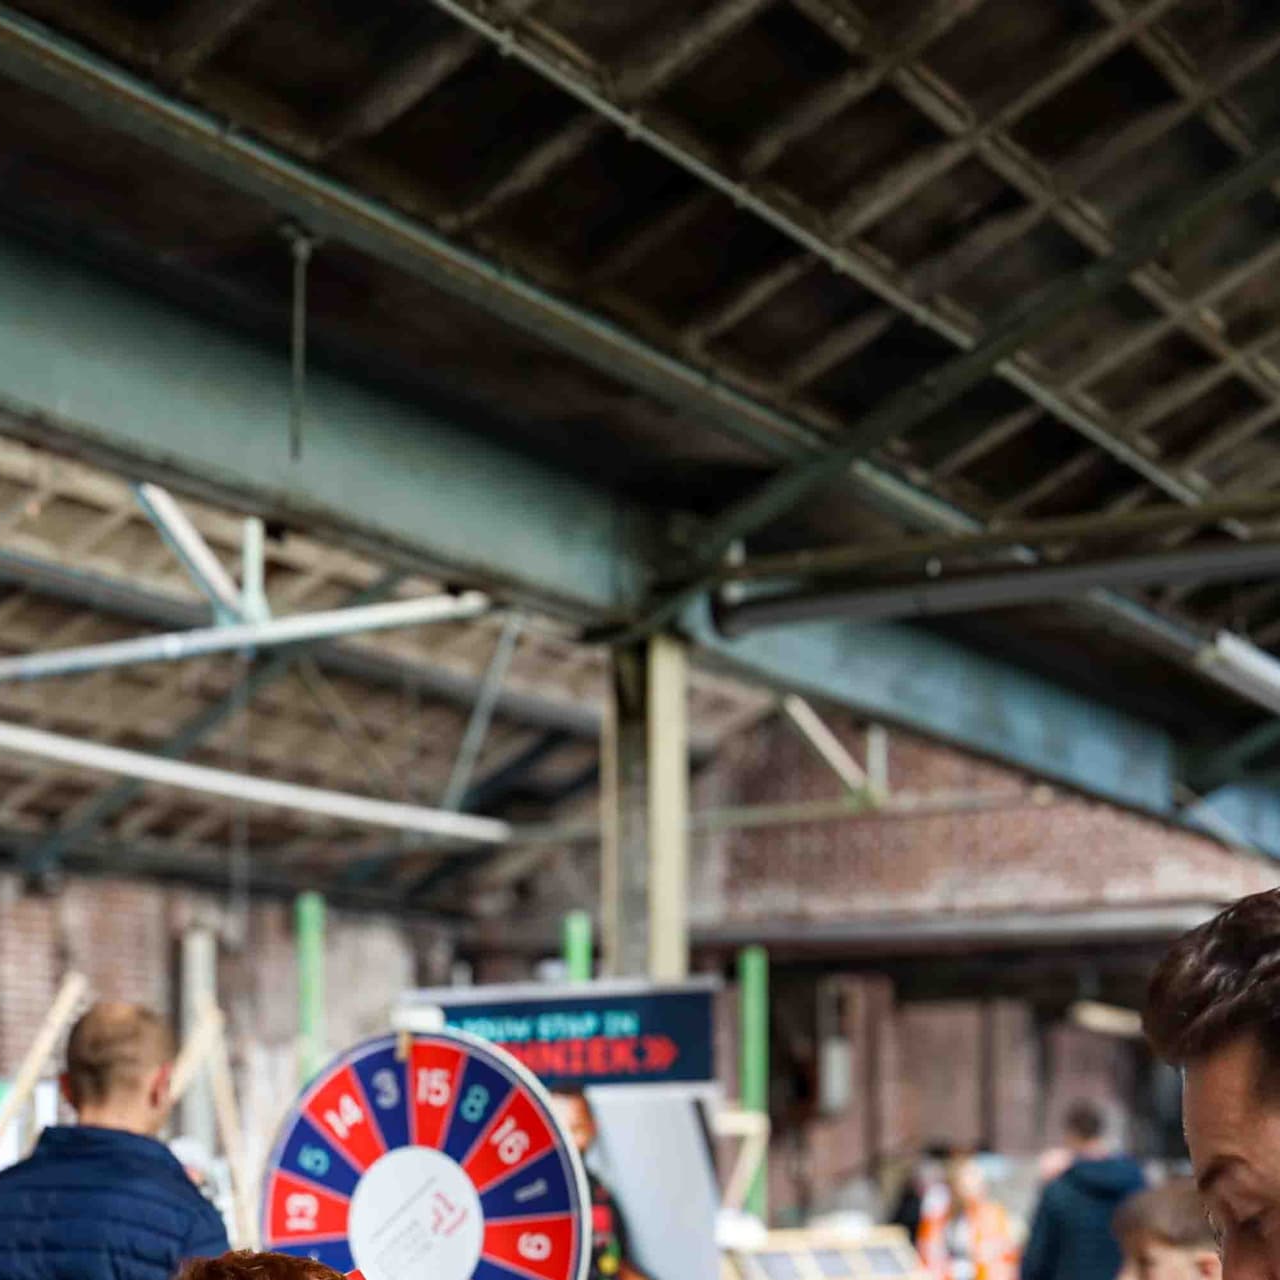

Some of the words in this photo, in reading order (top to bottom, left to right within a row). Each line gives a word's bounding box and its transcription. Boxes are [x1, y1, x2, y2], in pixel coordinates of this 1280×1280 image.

[371, 1069, 400, 1108] 3
[415, 1068, 451, 1107] 15
[461, 1085, 490, 1123] 8
[324, 1094, 363, 1139] 14
[490, 1116, 530, 1164] 16
[298, 1146, 331, 1176] 5
[285, 1194, 319, 1231] 13
